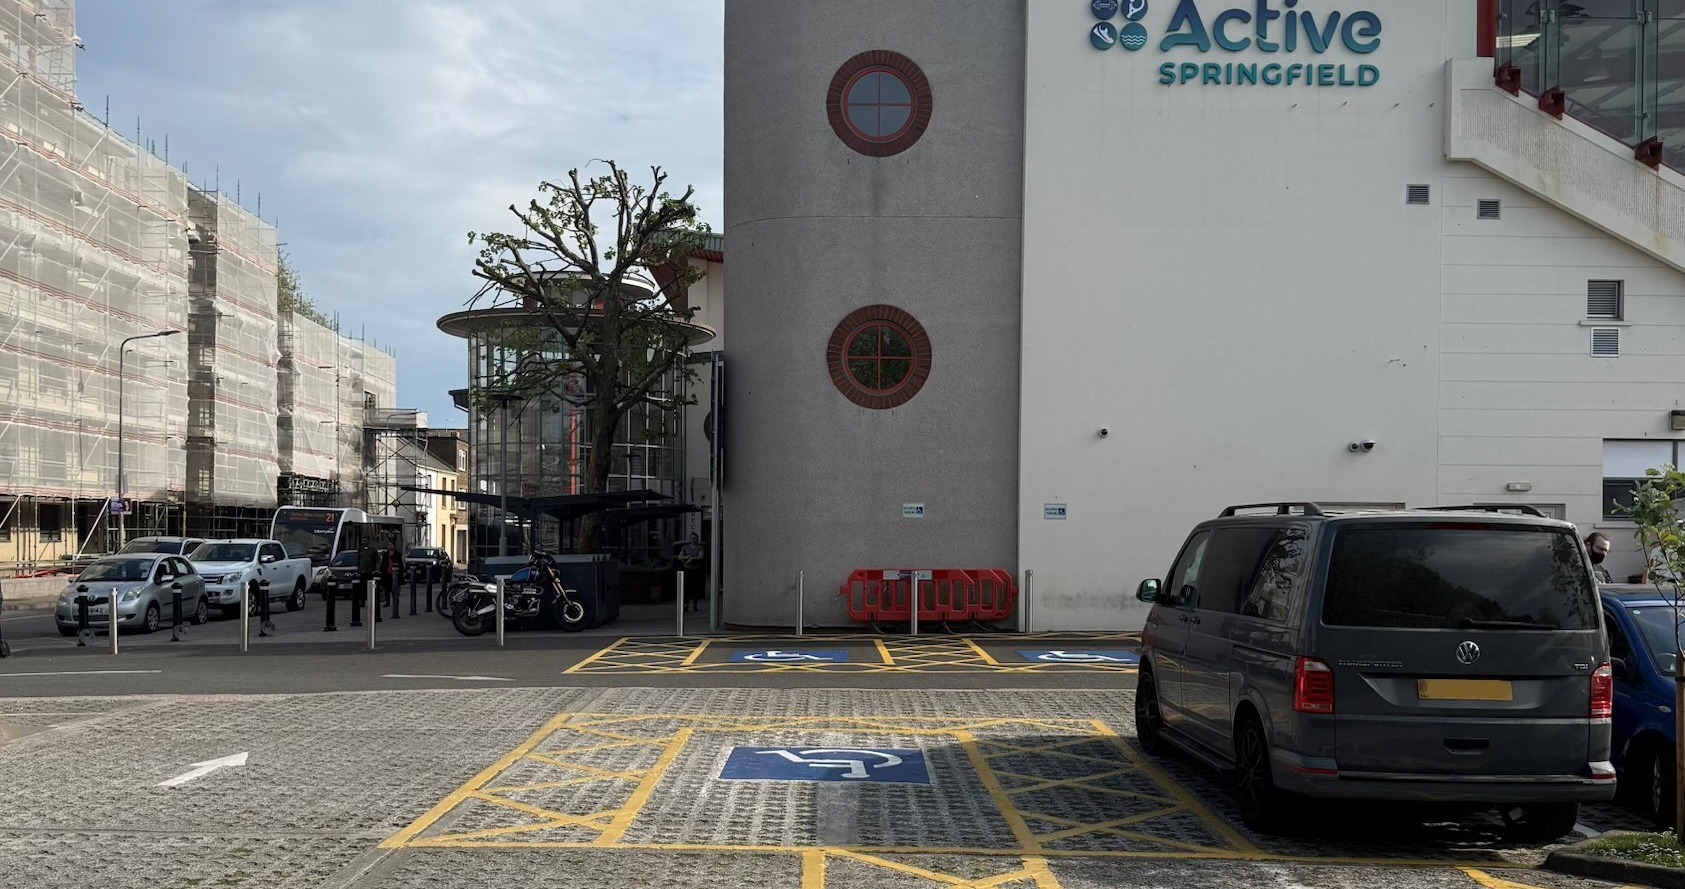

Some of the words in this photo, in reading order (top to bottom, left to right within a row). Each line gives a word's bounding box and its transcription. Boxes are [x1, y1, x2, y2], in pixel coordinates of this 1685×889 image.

[1159, 0, 1382, 53] Active
[1159, 62, 1380, 86] SPRINGFIELD
[325, 512, 335, 522] 21
